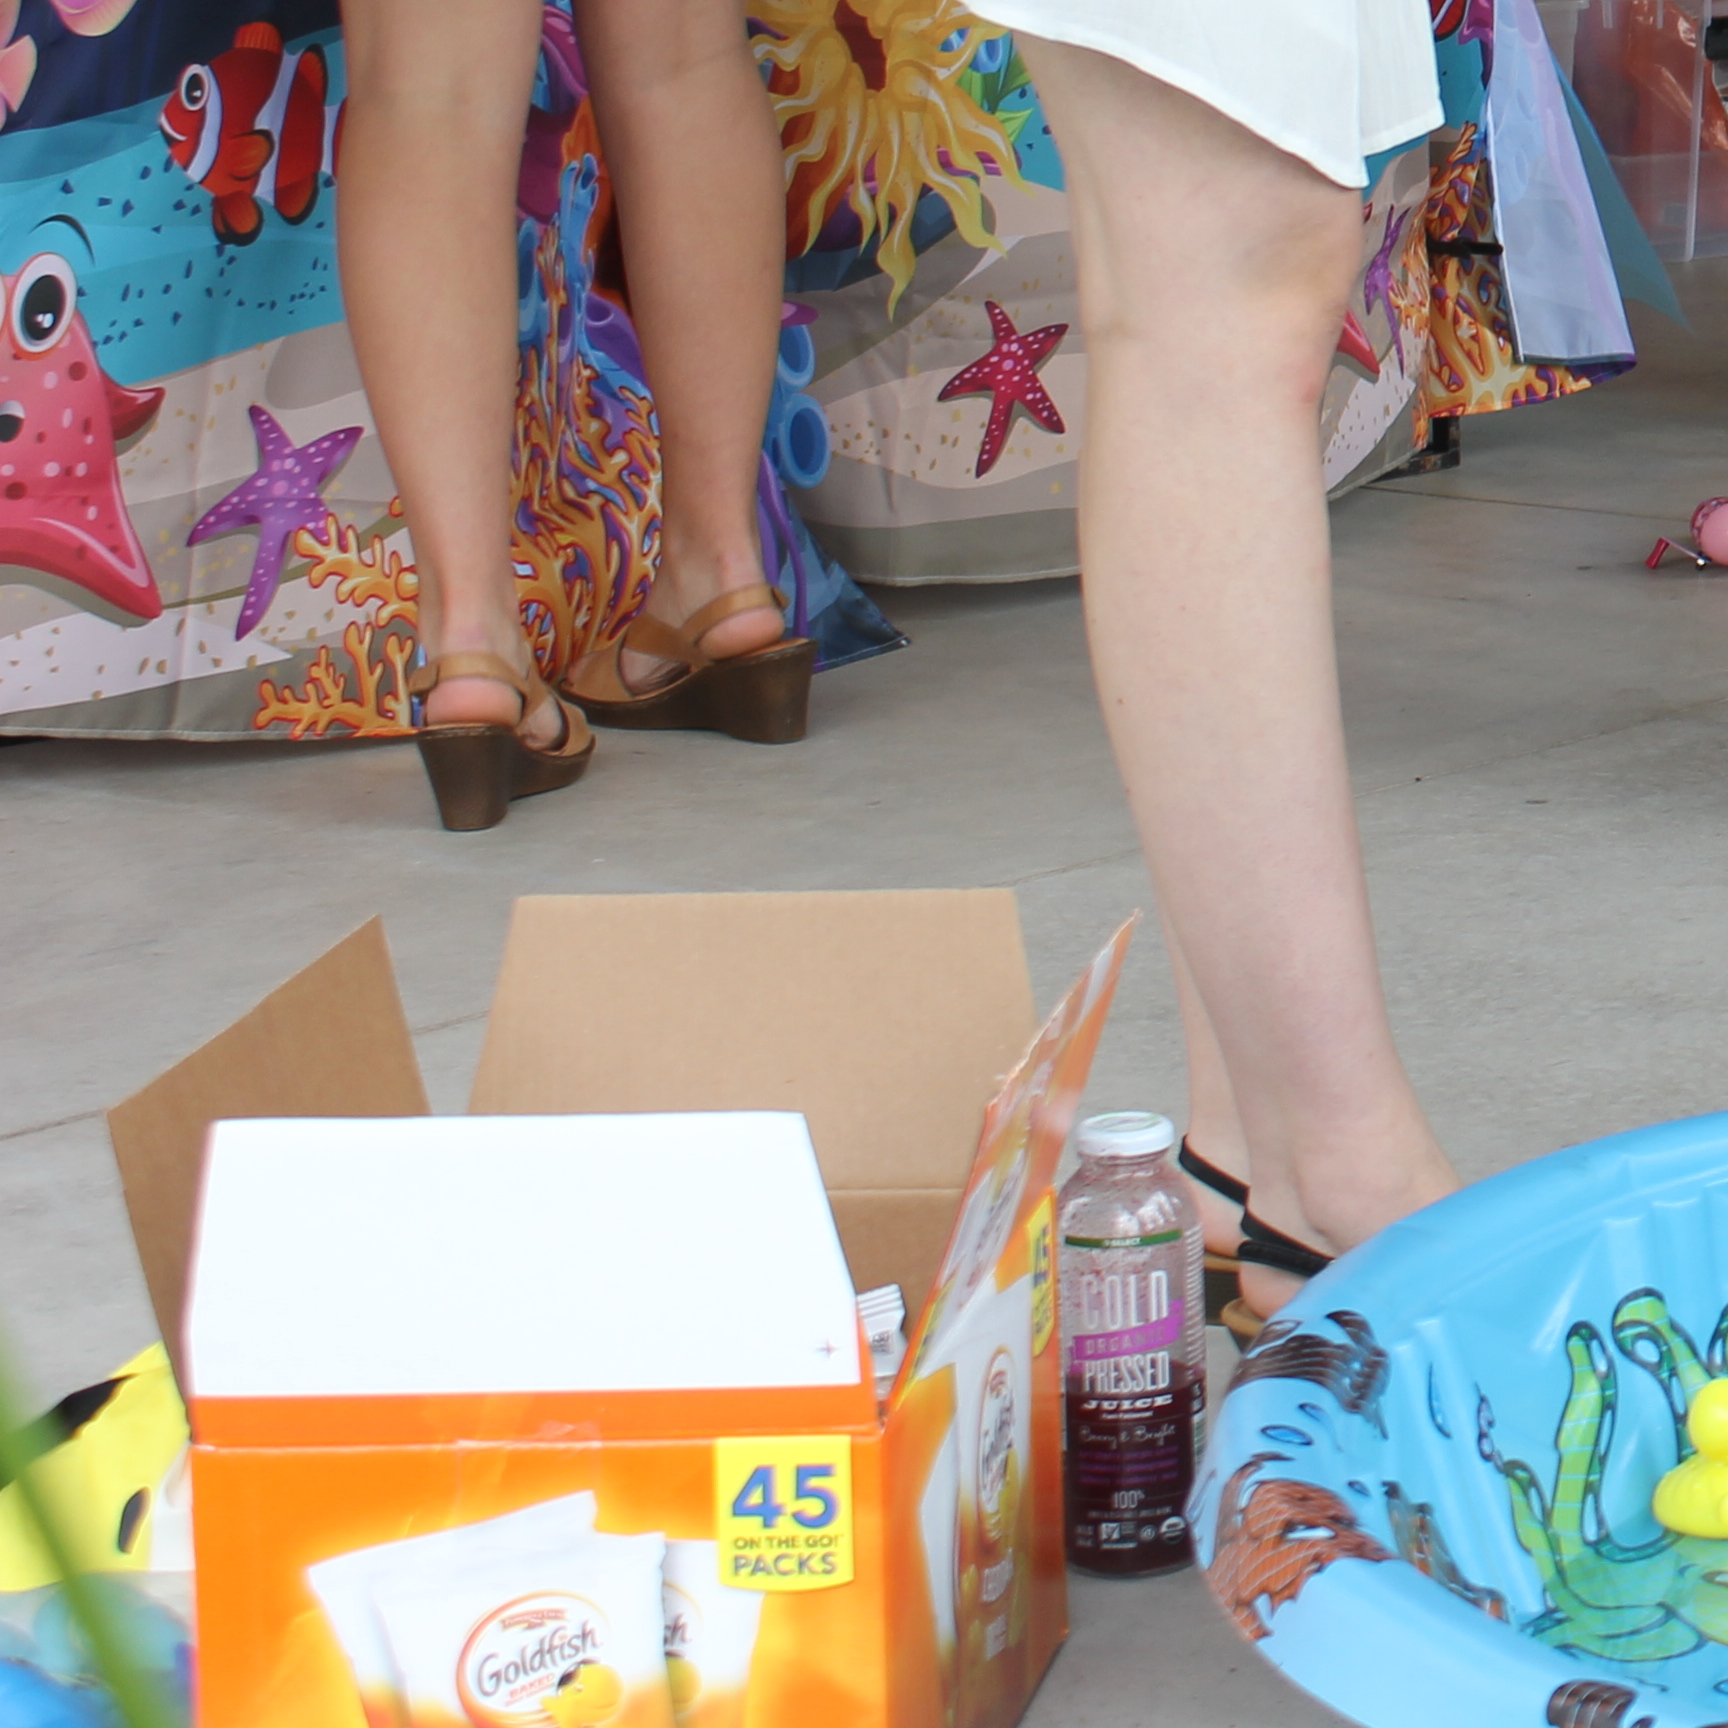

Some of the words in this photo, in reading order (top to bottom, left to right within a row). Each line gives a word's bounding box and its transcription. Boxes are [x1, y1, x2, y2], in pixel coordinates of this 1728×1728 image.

[1082, 1270, 1170, 1330] COLD
[1083, 1351, 1171, 1394] PRESSED
[1081, 1393, 1174, 1410] JUICE
[732, 1463, 840, 1530] 45
[733, 1536, 762, 1550] ON
[765, 1535, 801, 1549] THE
[733, 1551, 838, 1577] PACKS
[476, 1618, 600, 1699] Goldfish
